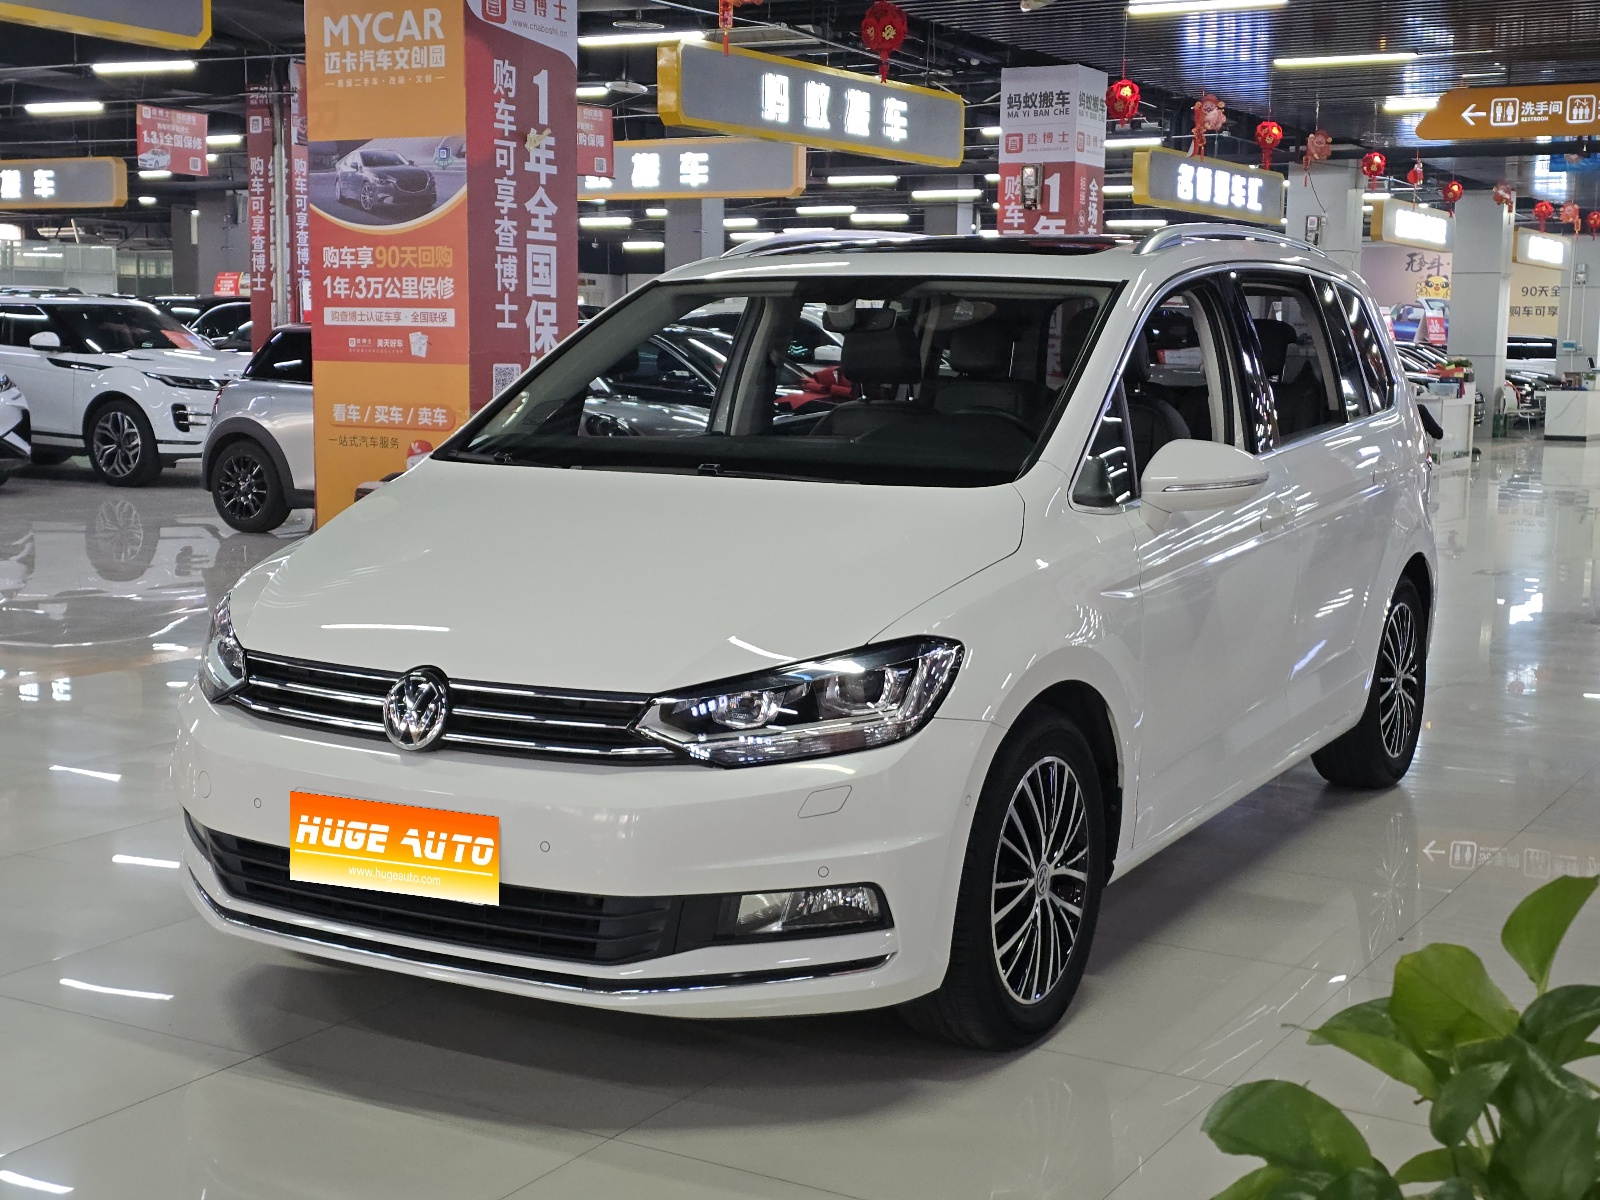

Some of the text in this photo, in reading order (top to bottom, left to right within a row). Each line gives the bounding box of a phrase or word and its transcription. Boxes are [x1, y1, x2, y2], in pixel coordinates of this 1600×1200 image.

[323, 8, 445, 47] MYCAR
[324, 45, 446, 74] 迈卡汽车文创园
[1006, 90, 1071, 110] 蚂蚁搬车
[1521, 101, 1563, 115] 洗手间
[1033, 109, 1050, 117] BAN
[1053, 107, 1070, 116] CHE
[577, 132, 605, 147] 购保障
[1027, 131, 1069, 145] 查博士
[493, 58, 519, 329] 购车可享查博士
[1003, 175, 1026, 234] 购车
[250, 157, 266, 292] 购车可享查博士
[524, 69, 559, 369] 1年全国保
[322, 246, 454, 268] 购车享90天回购
[323, 275, 455, 300] 1年/3万公里保修
[1521, 285, 1561, 297] 90天全
[1509, 305, 1559, 317] 购车可享
[328, 434, 400, 449] 一站式汽车服务
